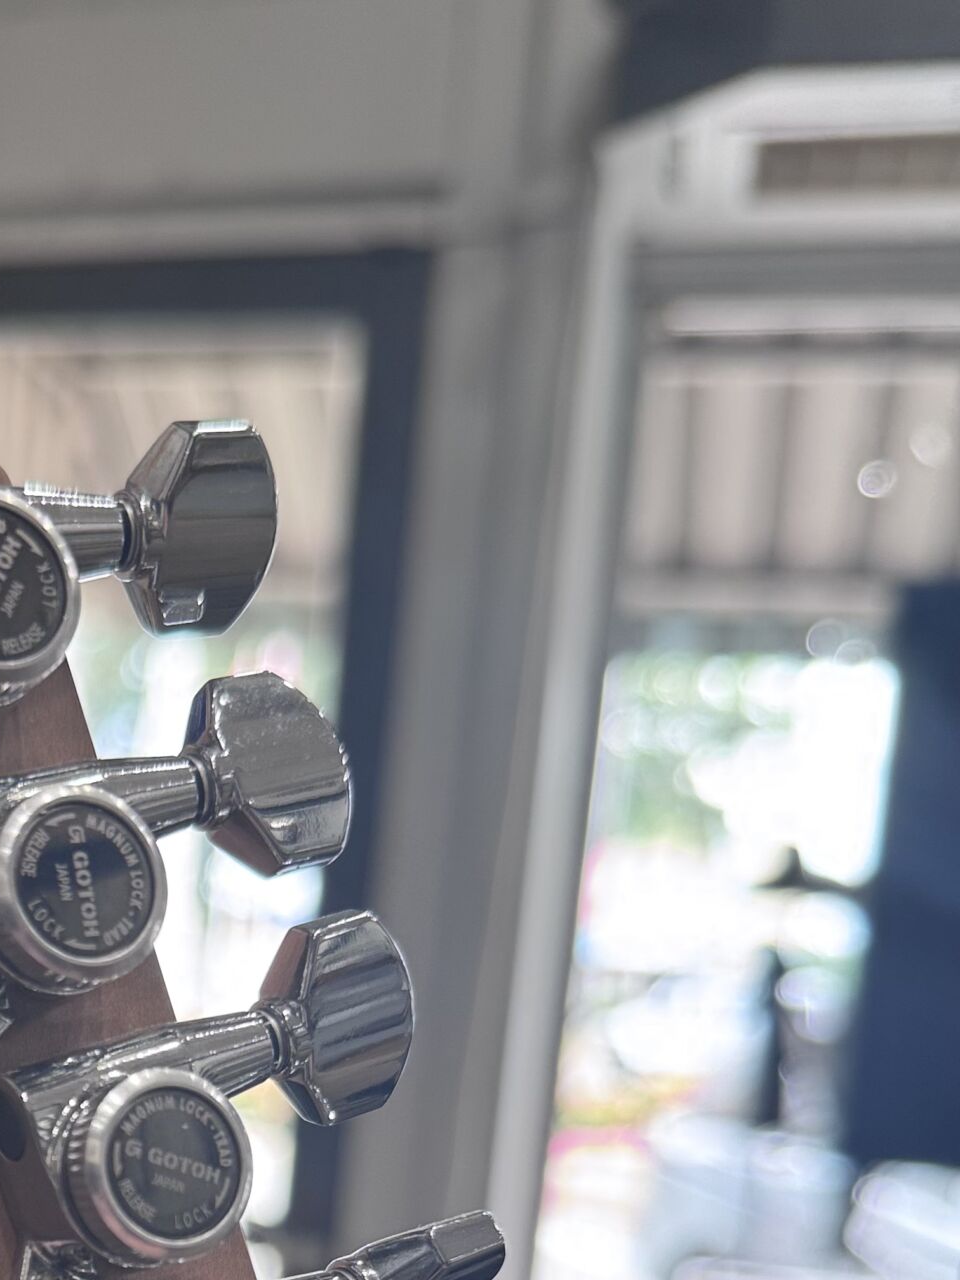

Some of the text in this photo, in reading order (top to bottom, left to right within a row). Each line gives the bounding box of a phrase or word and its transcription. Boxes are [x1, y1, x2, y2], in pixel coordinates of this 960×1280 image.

[0, 580, 24, 618] JAPAN
[37, 561, 56, 608] LOCK
[20, 829, 50, 878] RELEASE
[54, 863, 73, 901] JAPAN
[72, 851, 100, 937] GOTOH
[86, 814, 144, 946] MAGNUM LOCK TRAD
[27, 899, 67, 940] LOCK
[120, 1095, 233, 1168] MAGNUM LOCK TRAD
[147, 1146, 222, 1185] GOTOH
[151, 1172, 186, 1194] JAPAN
[174, 1203, 213, 1230] LOCK
